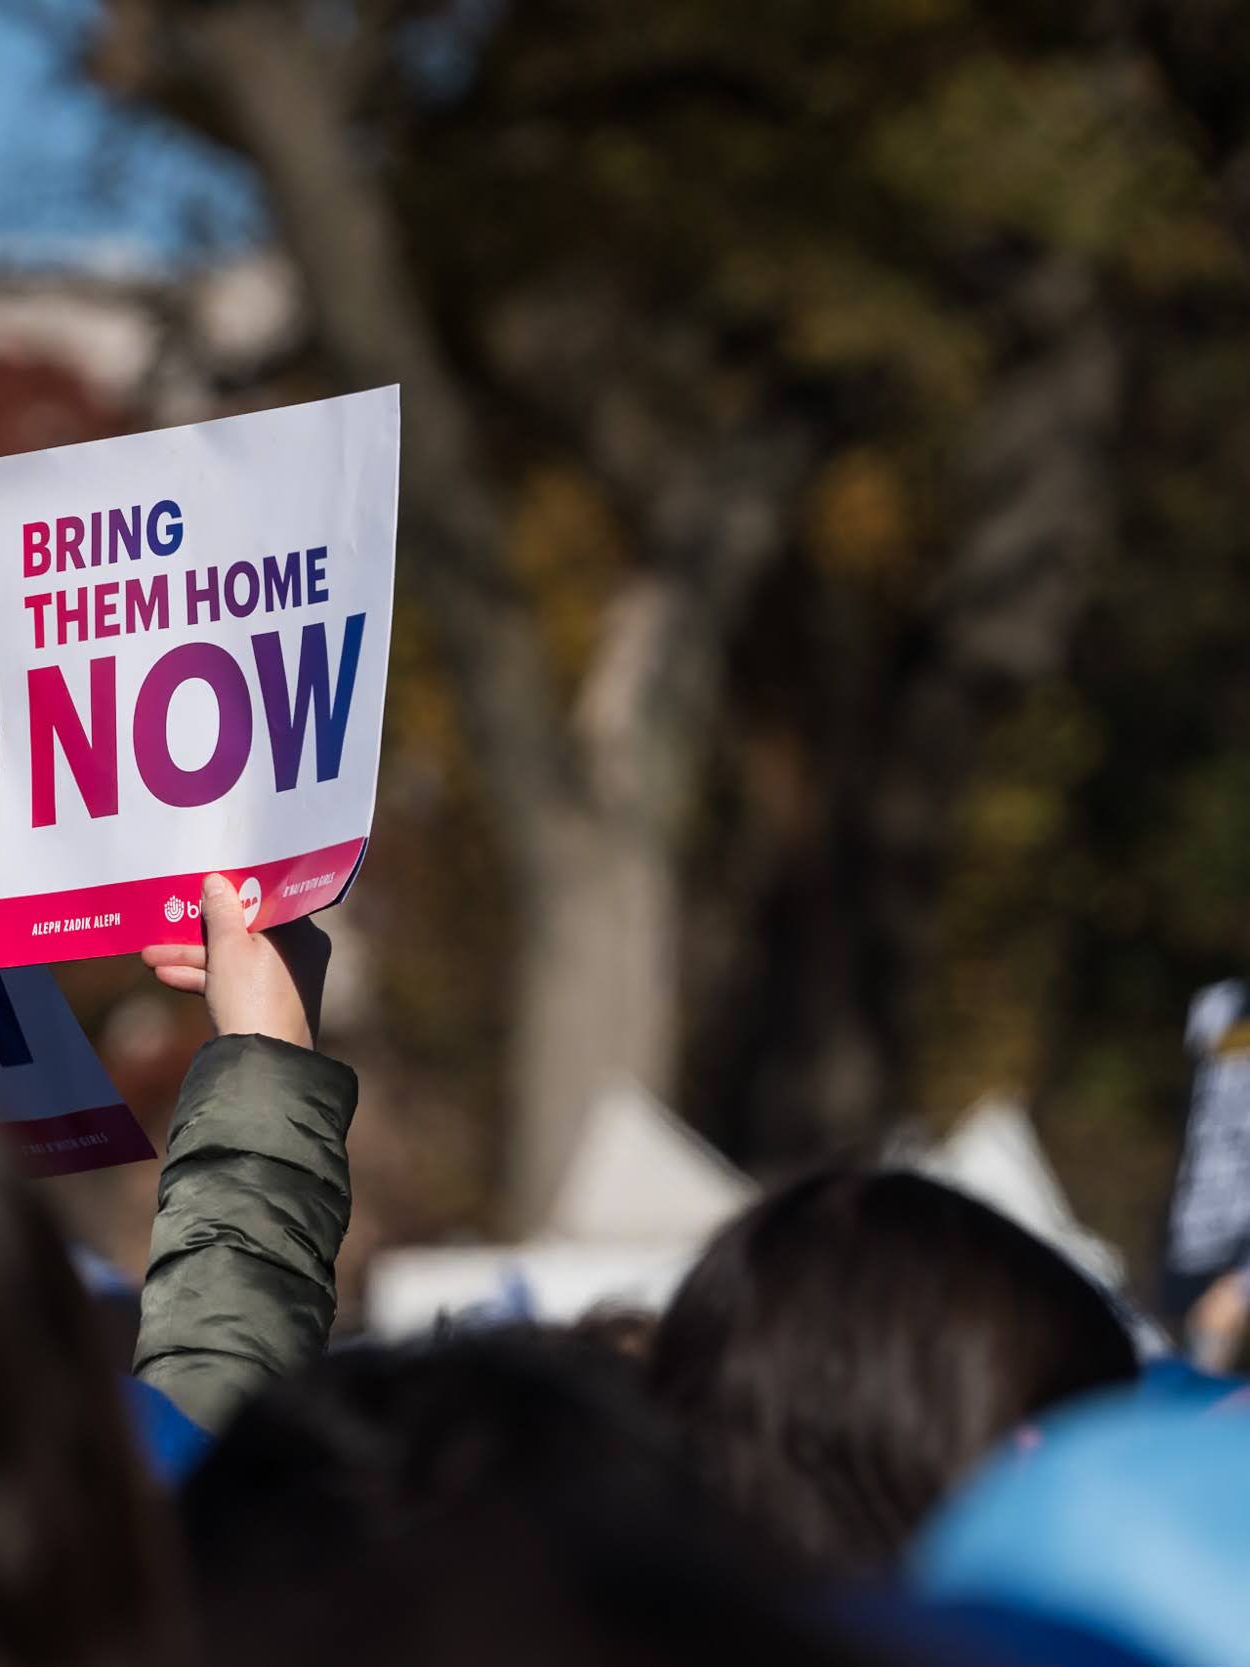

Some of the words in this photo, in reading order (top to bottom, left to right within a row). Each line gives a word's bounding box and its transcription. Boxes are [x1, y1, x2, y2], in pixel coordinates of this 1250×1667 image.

[22, 500, 184, 578] BRING
[24, 573, 170, 649] THEM
[186, 545, 329, 626] HOME
[27, 611, 367, 829] NOW
[31, 920, 61, 936] ALEPH
[63, 916, 91, 932] ZADIK
[93, 913, 121, 929] ALEPH
